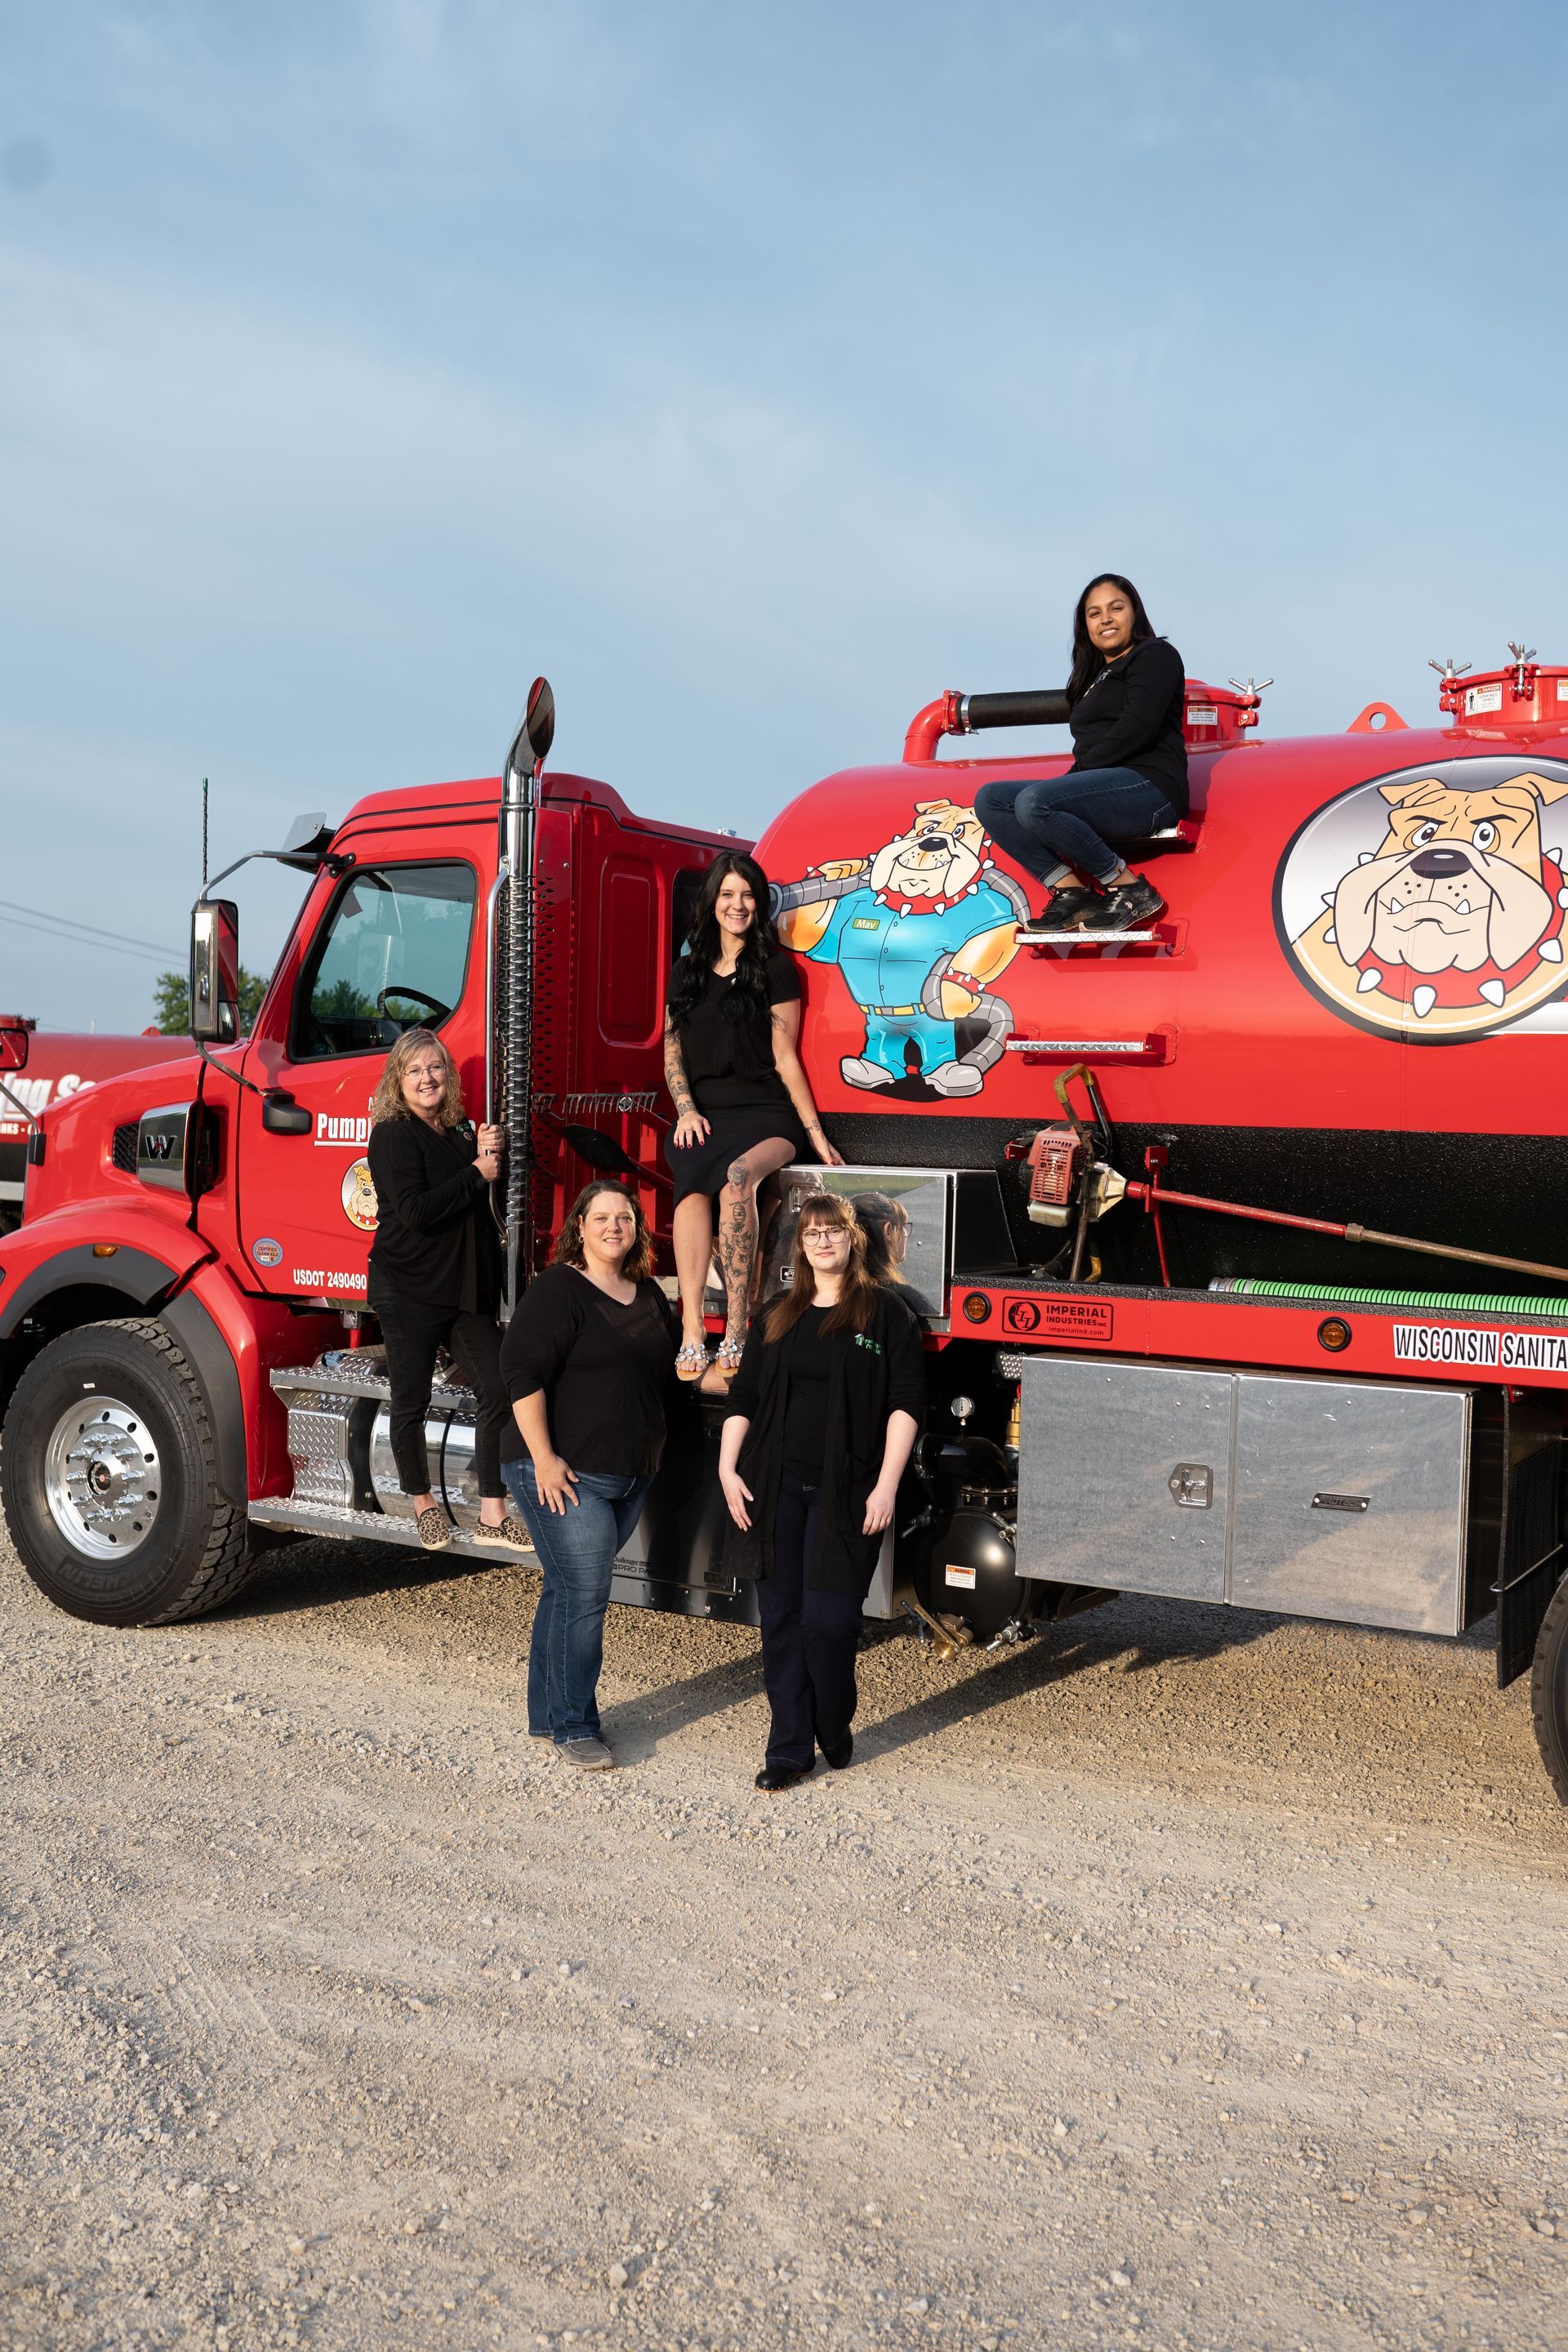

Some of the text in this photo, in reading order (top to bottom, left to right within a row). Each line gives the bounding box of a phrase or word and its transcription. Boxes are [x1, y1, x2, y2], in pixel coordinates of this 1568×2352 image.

[0, 1072, 53, 1117] ing
[0, 1123, 20, 1135] NKS
[293, 1269, 368, 1290] USDOT 2490490
[1046, 1305, 1107, 1318] IMPERIAL
[1046, 1316, 1098, 1326] INDUSTRIES
[1049, 1326, 1104, 1336] imperialind.com
[1396, 1327, 1568, 1369] WISCONSIN SANITA
[618, 1564, 637, 1573] PRO
